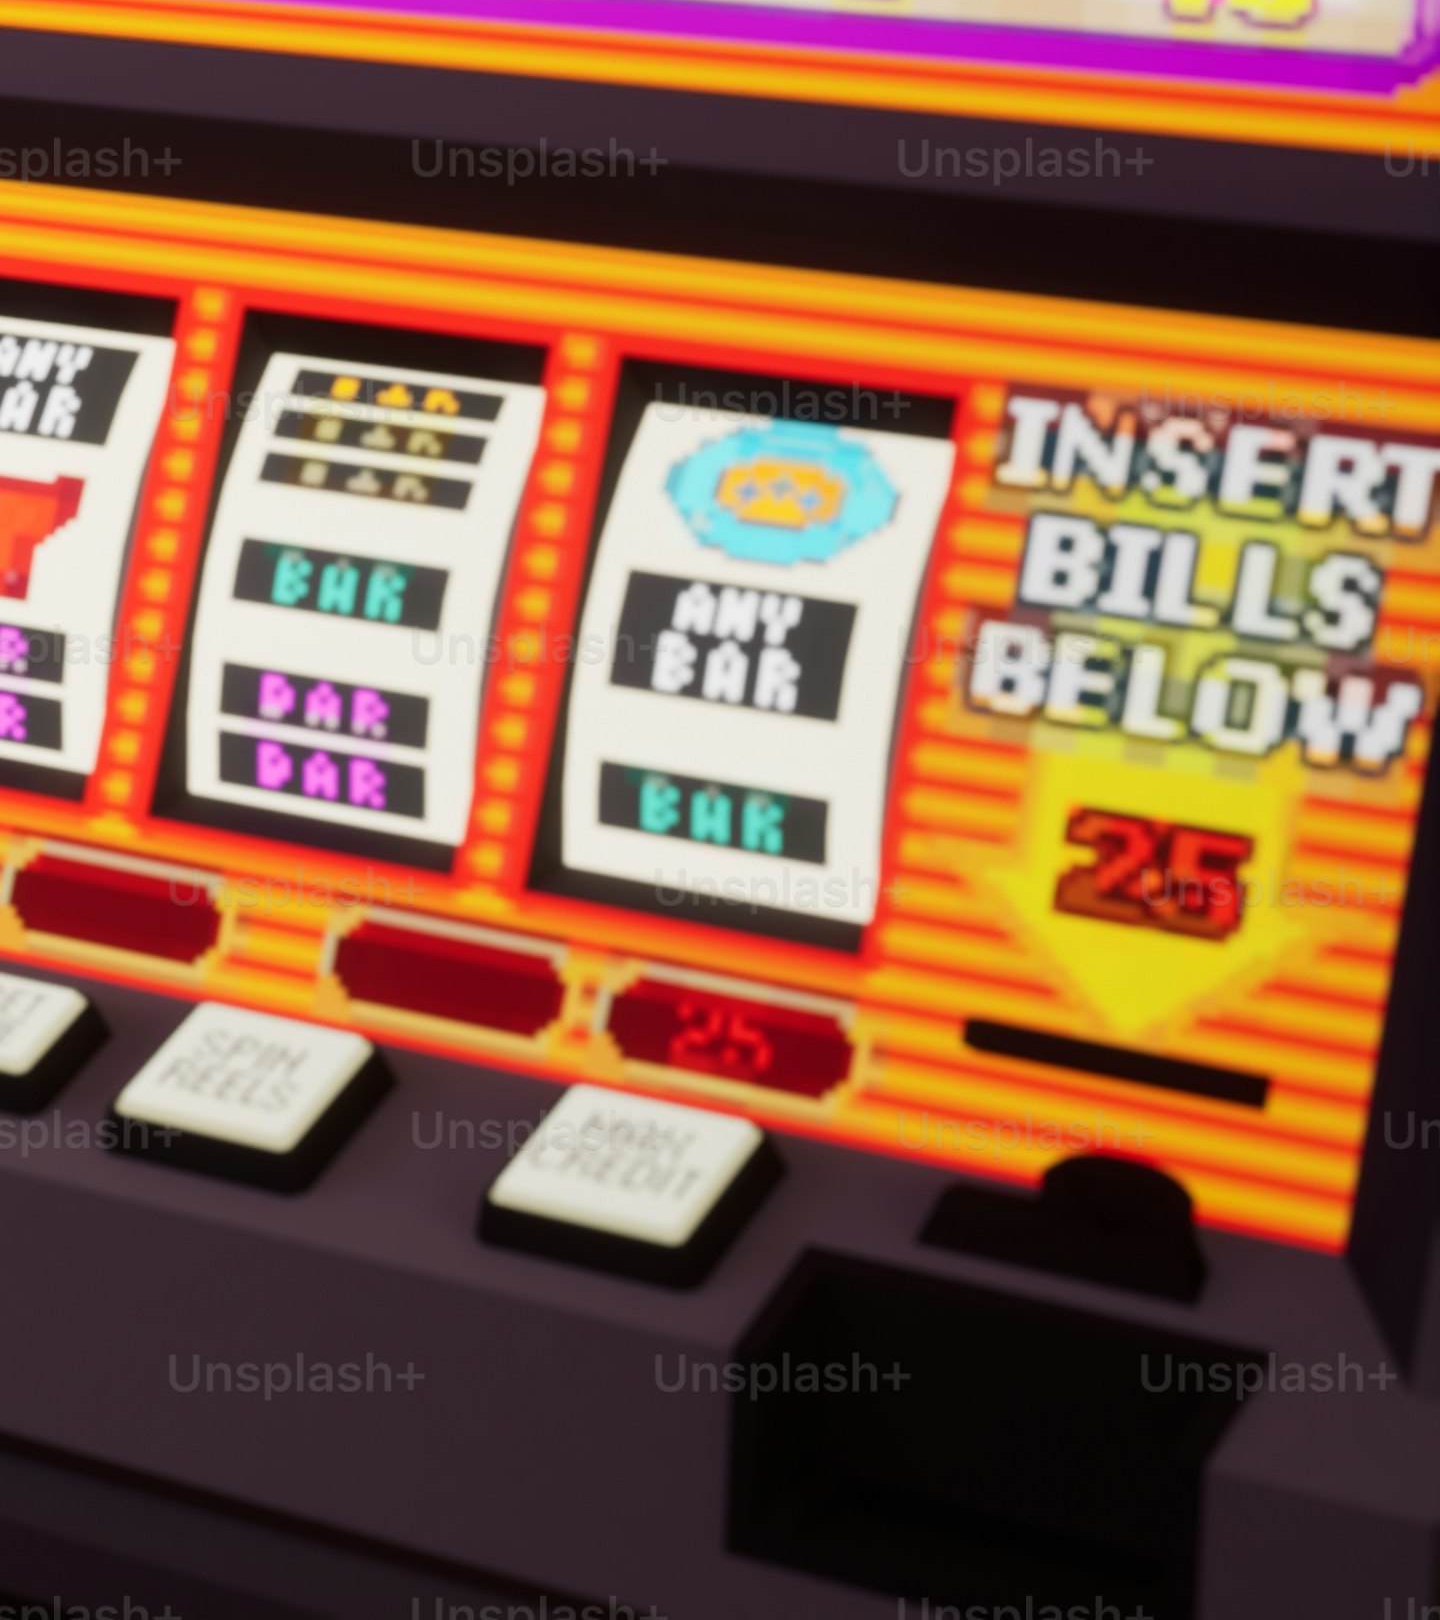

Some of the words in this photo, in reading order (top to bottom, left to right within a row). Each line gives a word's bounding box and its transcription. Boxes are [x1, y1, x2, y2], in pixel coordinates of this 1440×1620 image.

[997, 397, 1440, 539] INSERT
[272, 549, 405, 623] BAR
[672, 582, 803, 647] ANY
[1018, 511, 1383, 653] BILLS
[651, 628, 800, 712] BAR
[965, 620, 1423, 772] BELOW
[640, 778, 785, 855] BAR
[1052, 805, 1254, 939] 25
[199, 1027, 310, 1074] SPIN
[670, 1000, 774, 1073] 25
